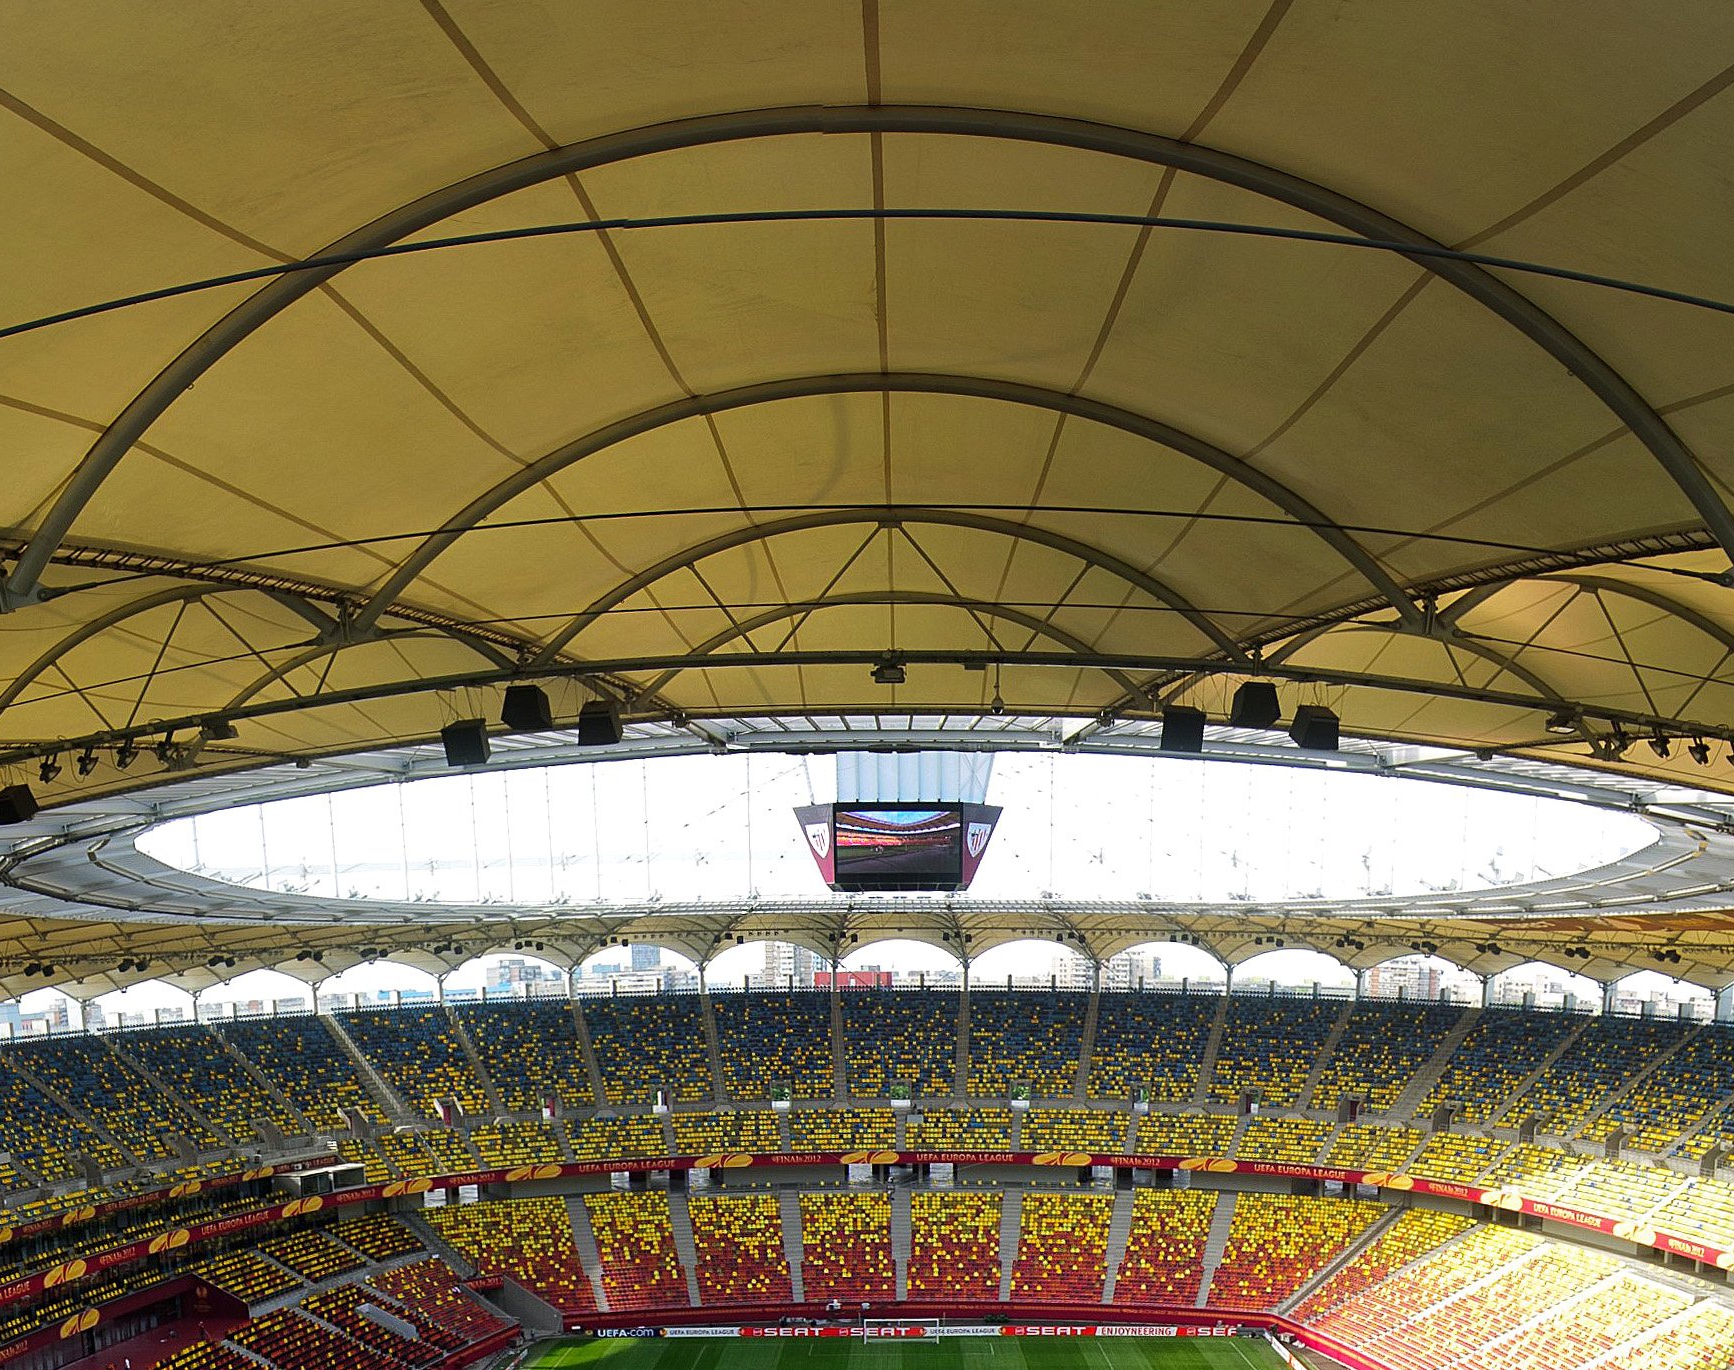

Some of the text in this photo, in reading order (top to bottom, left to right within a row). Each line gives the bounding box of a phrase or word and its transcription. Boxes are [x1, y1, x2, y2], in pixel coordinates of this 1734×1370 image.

[803, 1154, 821, 1162] 2012
[916, 1153, 1014, 1162] UEFA EUROPA LEAGUE
[1142, 1158, 1160, 1166] 2012
[578, 1160, 676, 1173] UEFA EUROPA LEAGUE
[1254, 1164, 1346, 1179] UEFA EUROPA LEAGUE
[201, 1210, 269, 1236] UEFA EUROPA LEAGUE
[4, 1280, 30, 1299] LEAGUE
[764, 1327, 823, 1337] SEAT
[850, 1327, 910, 1337] SEAT
[1026, 1326, 1086, 1336] SEAT
[1101, 1327, 1171, 1336] ENJOYNEERING
[1197, 1327, 1237, 1336] SEA
